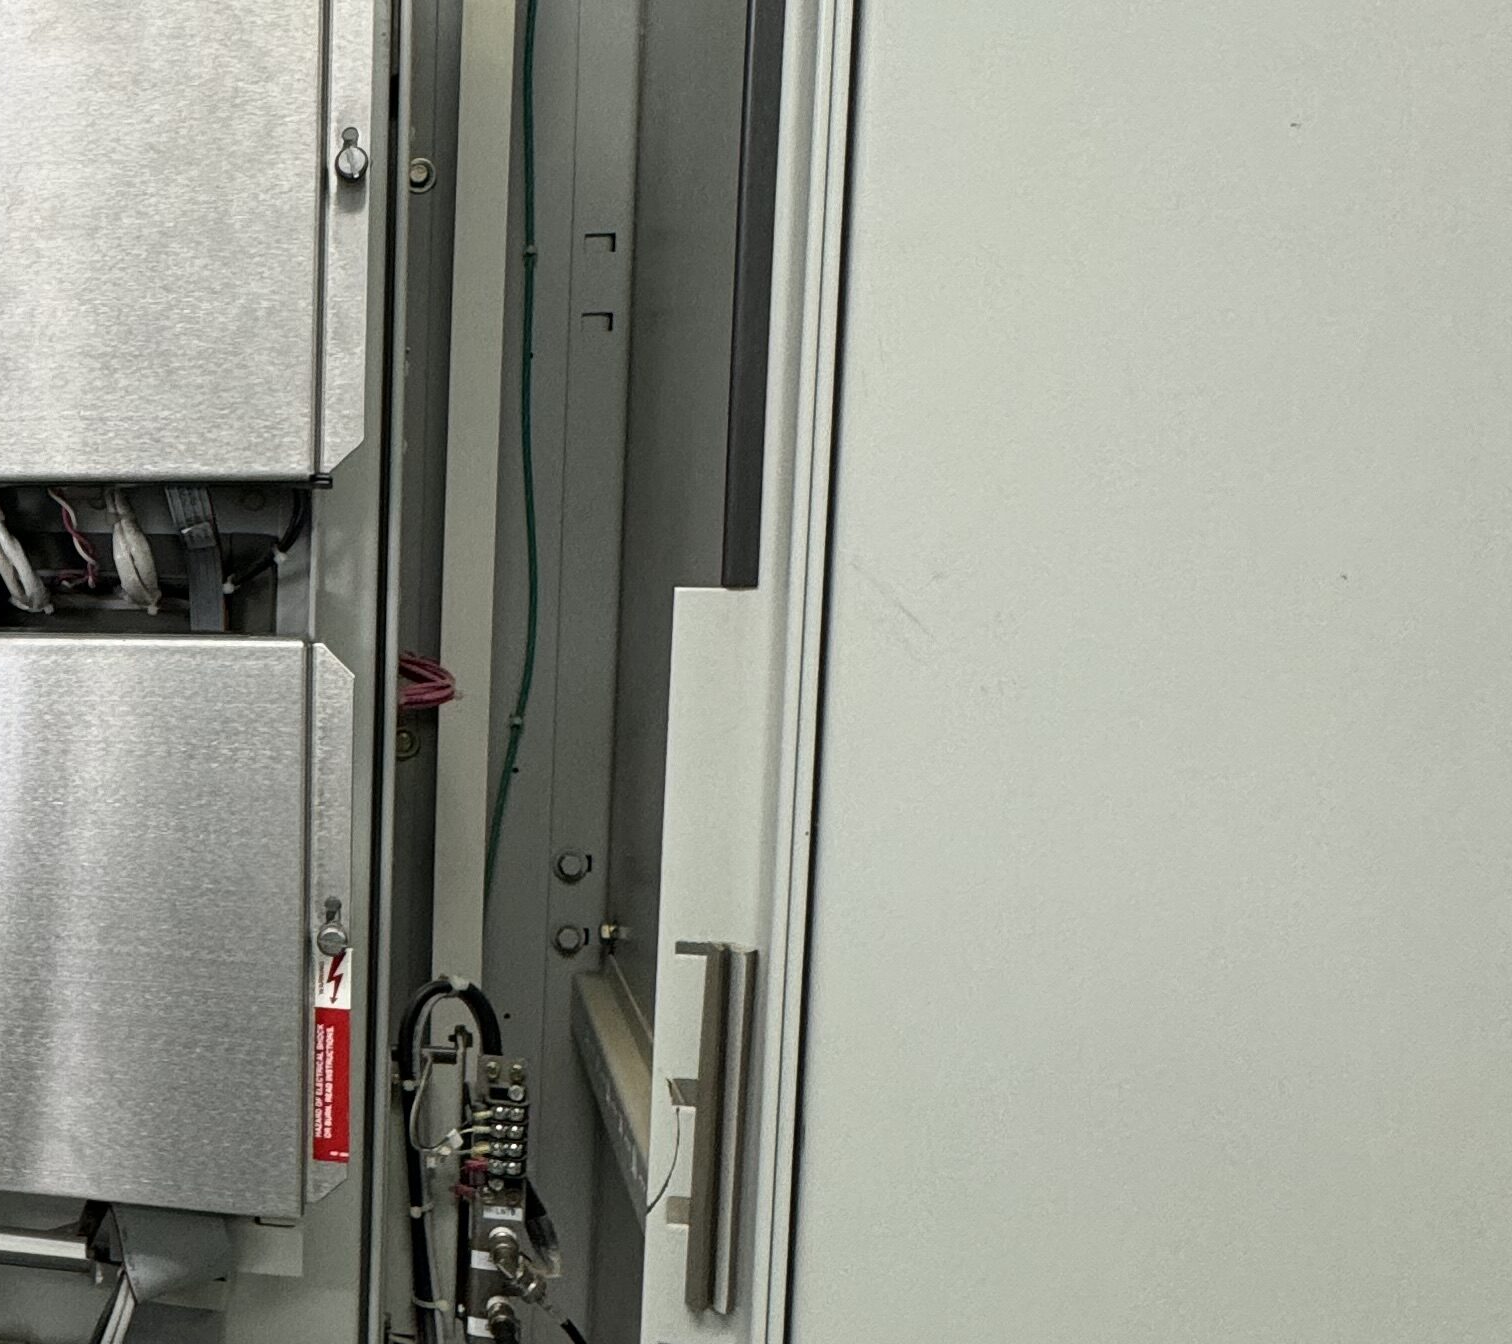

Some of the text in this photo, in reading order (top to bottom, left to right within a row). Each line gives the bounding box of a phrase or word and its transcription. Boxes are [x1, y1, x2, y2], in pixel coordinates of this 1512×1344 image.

[316, 1023, 325, 1050] SHOCK
[315, 1051, 324, 1096] ELECTRICAL
[314, 1108, 323, 1138] HAZARD
